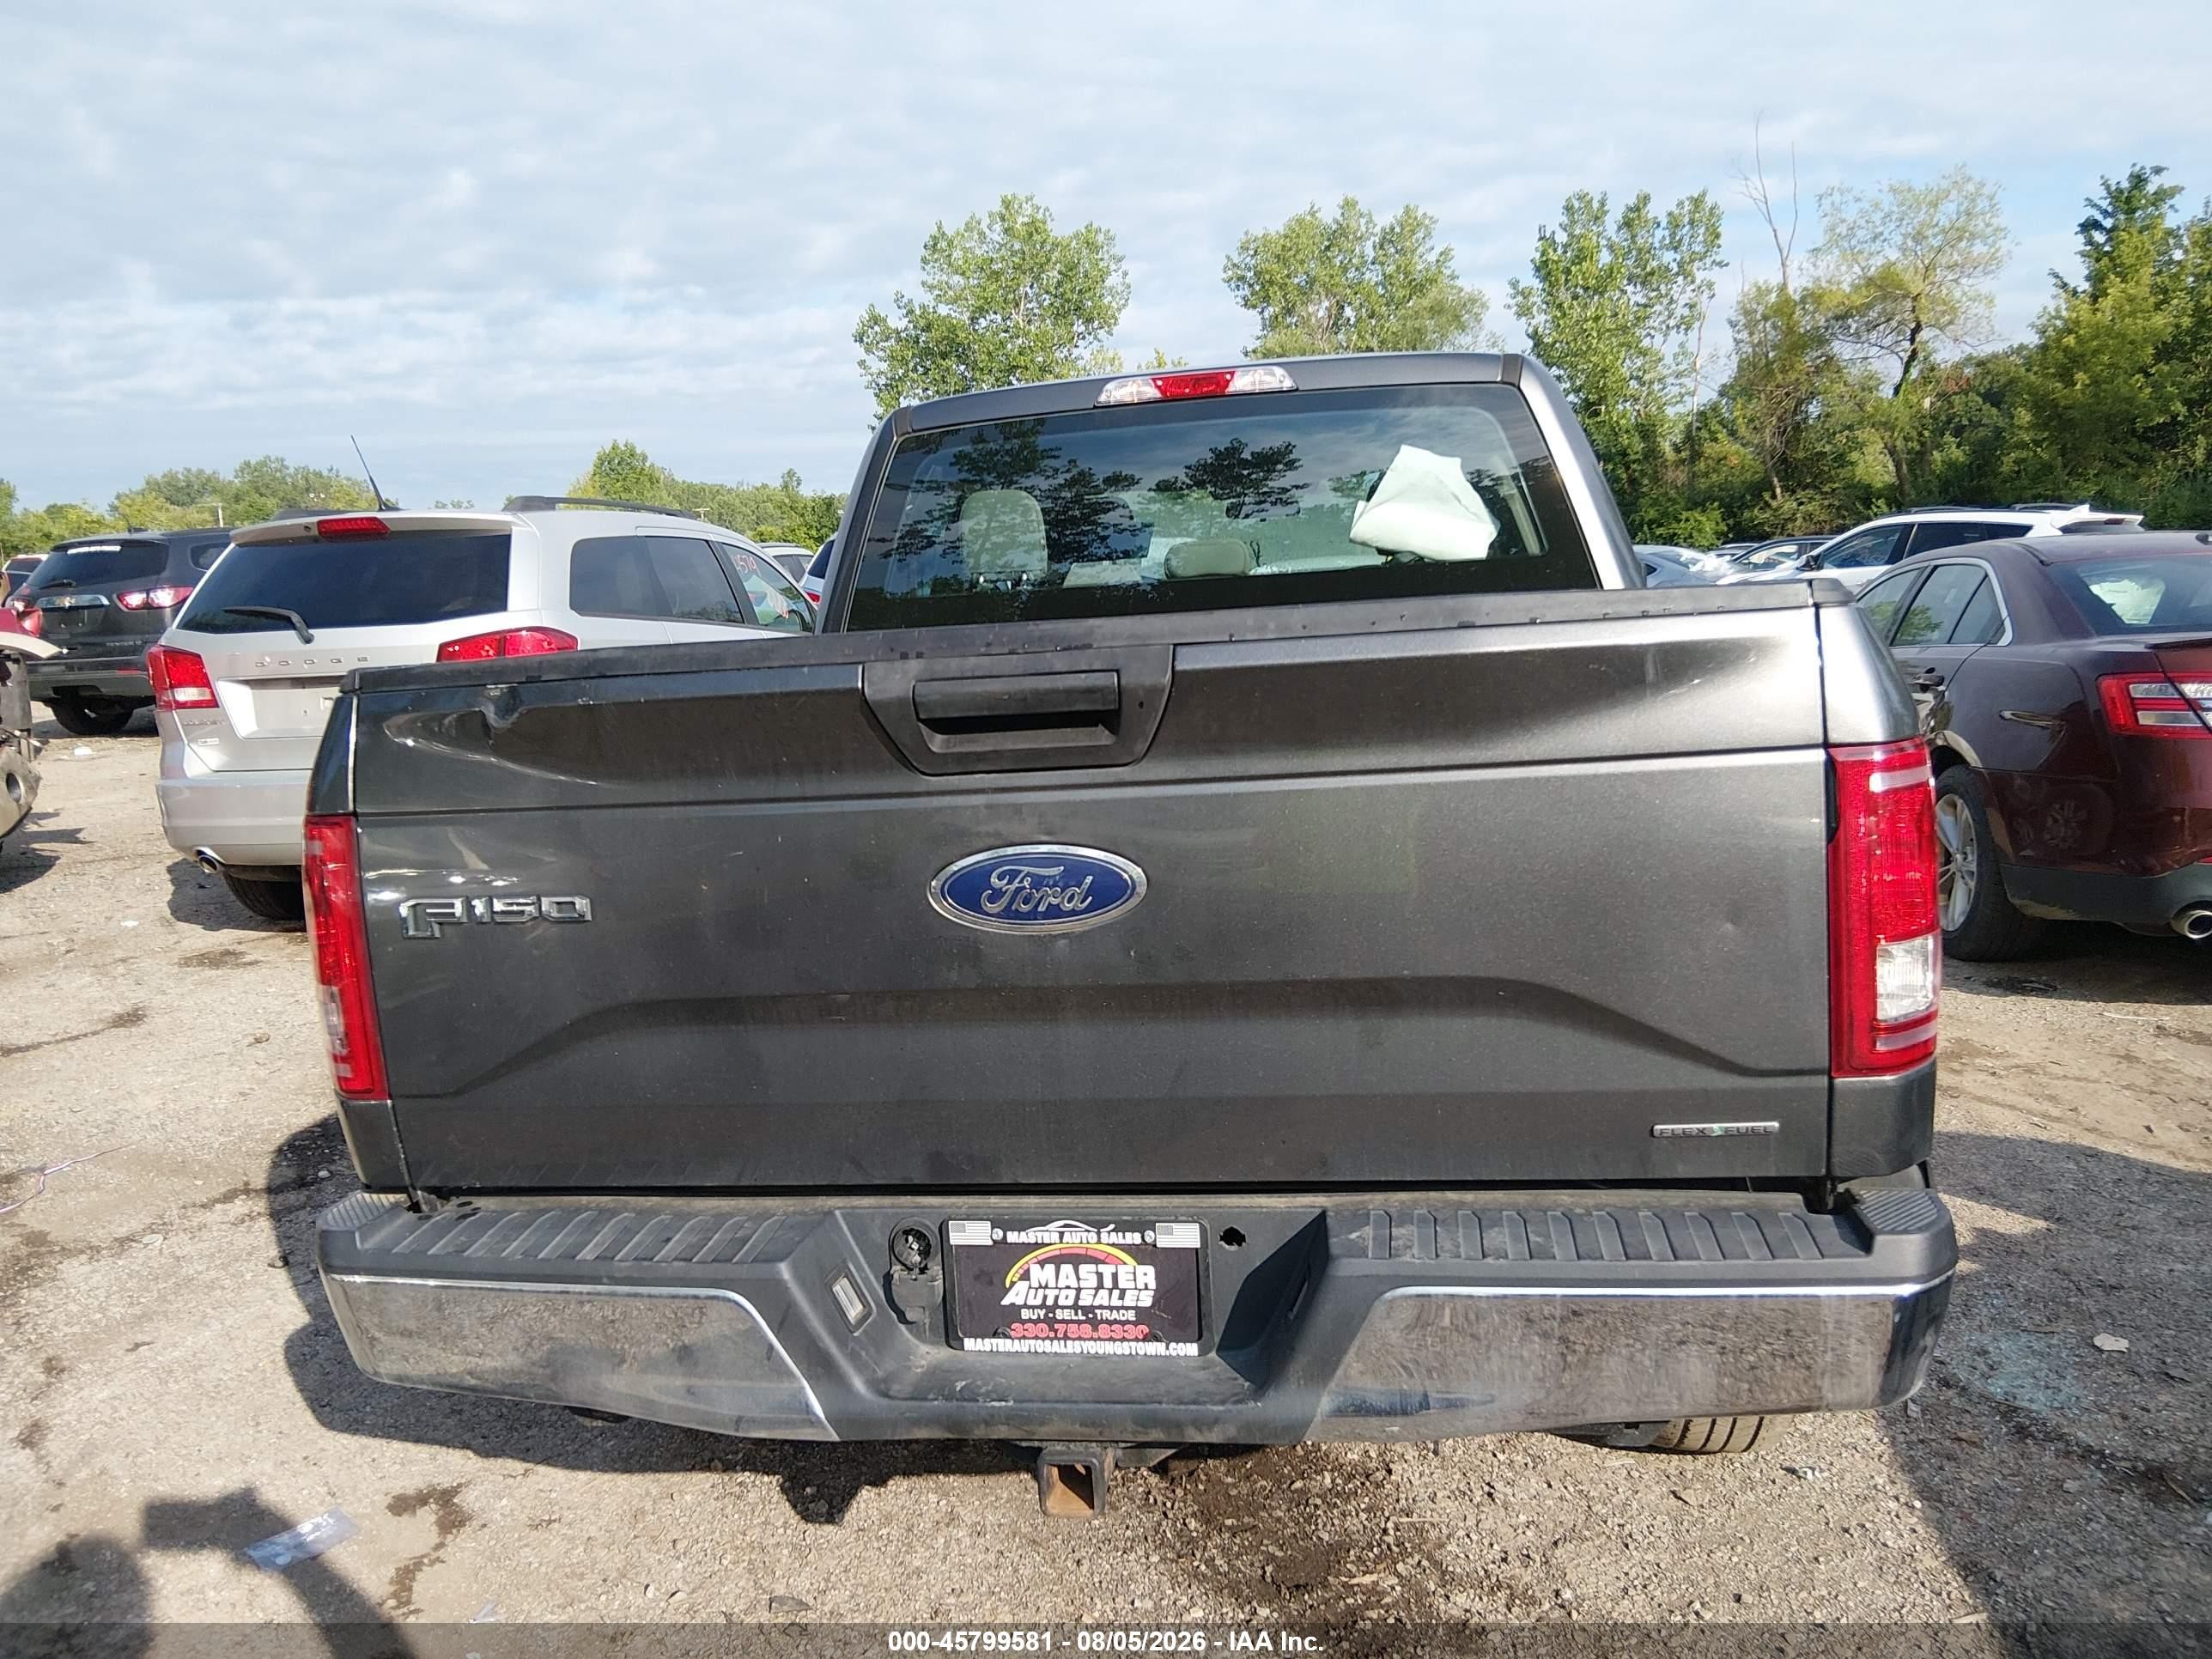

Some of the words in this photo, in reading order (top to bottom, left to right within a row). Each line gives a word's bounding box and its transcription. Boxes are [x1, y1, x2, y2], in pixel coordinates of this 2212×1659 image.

[255, 656, 368, 667] DODGE
[981, 866, 1093, 914] Ford
[1658, 1127, 1707, 1136] FLEX
[1723, 1125, 1773, 1134] FUEL
[1006, 1231, 1060, 1243] MASTER
[1062, 1231, 1098, 1243] AUTO
[1100, 1231, 1142, 1244] SALES
[1030, 1263, 1156, 1290] MASTER
[1000, 1280, 1077, 1306] AUTO
[1078, 1289, 1155, 1307] SALES
[1021, 1309, 1045, 1320] BUY
[1054, 1310, 1086, 1321] SELL
[1095, 1310, 1137, 1322] TRADE
[1010, 1322, 1150, 1340] 330.758.8330
[963, 1338, 1199, 1356] MASTERAUTOSALESYOUNGSTOWN.COM
